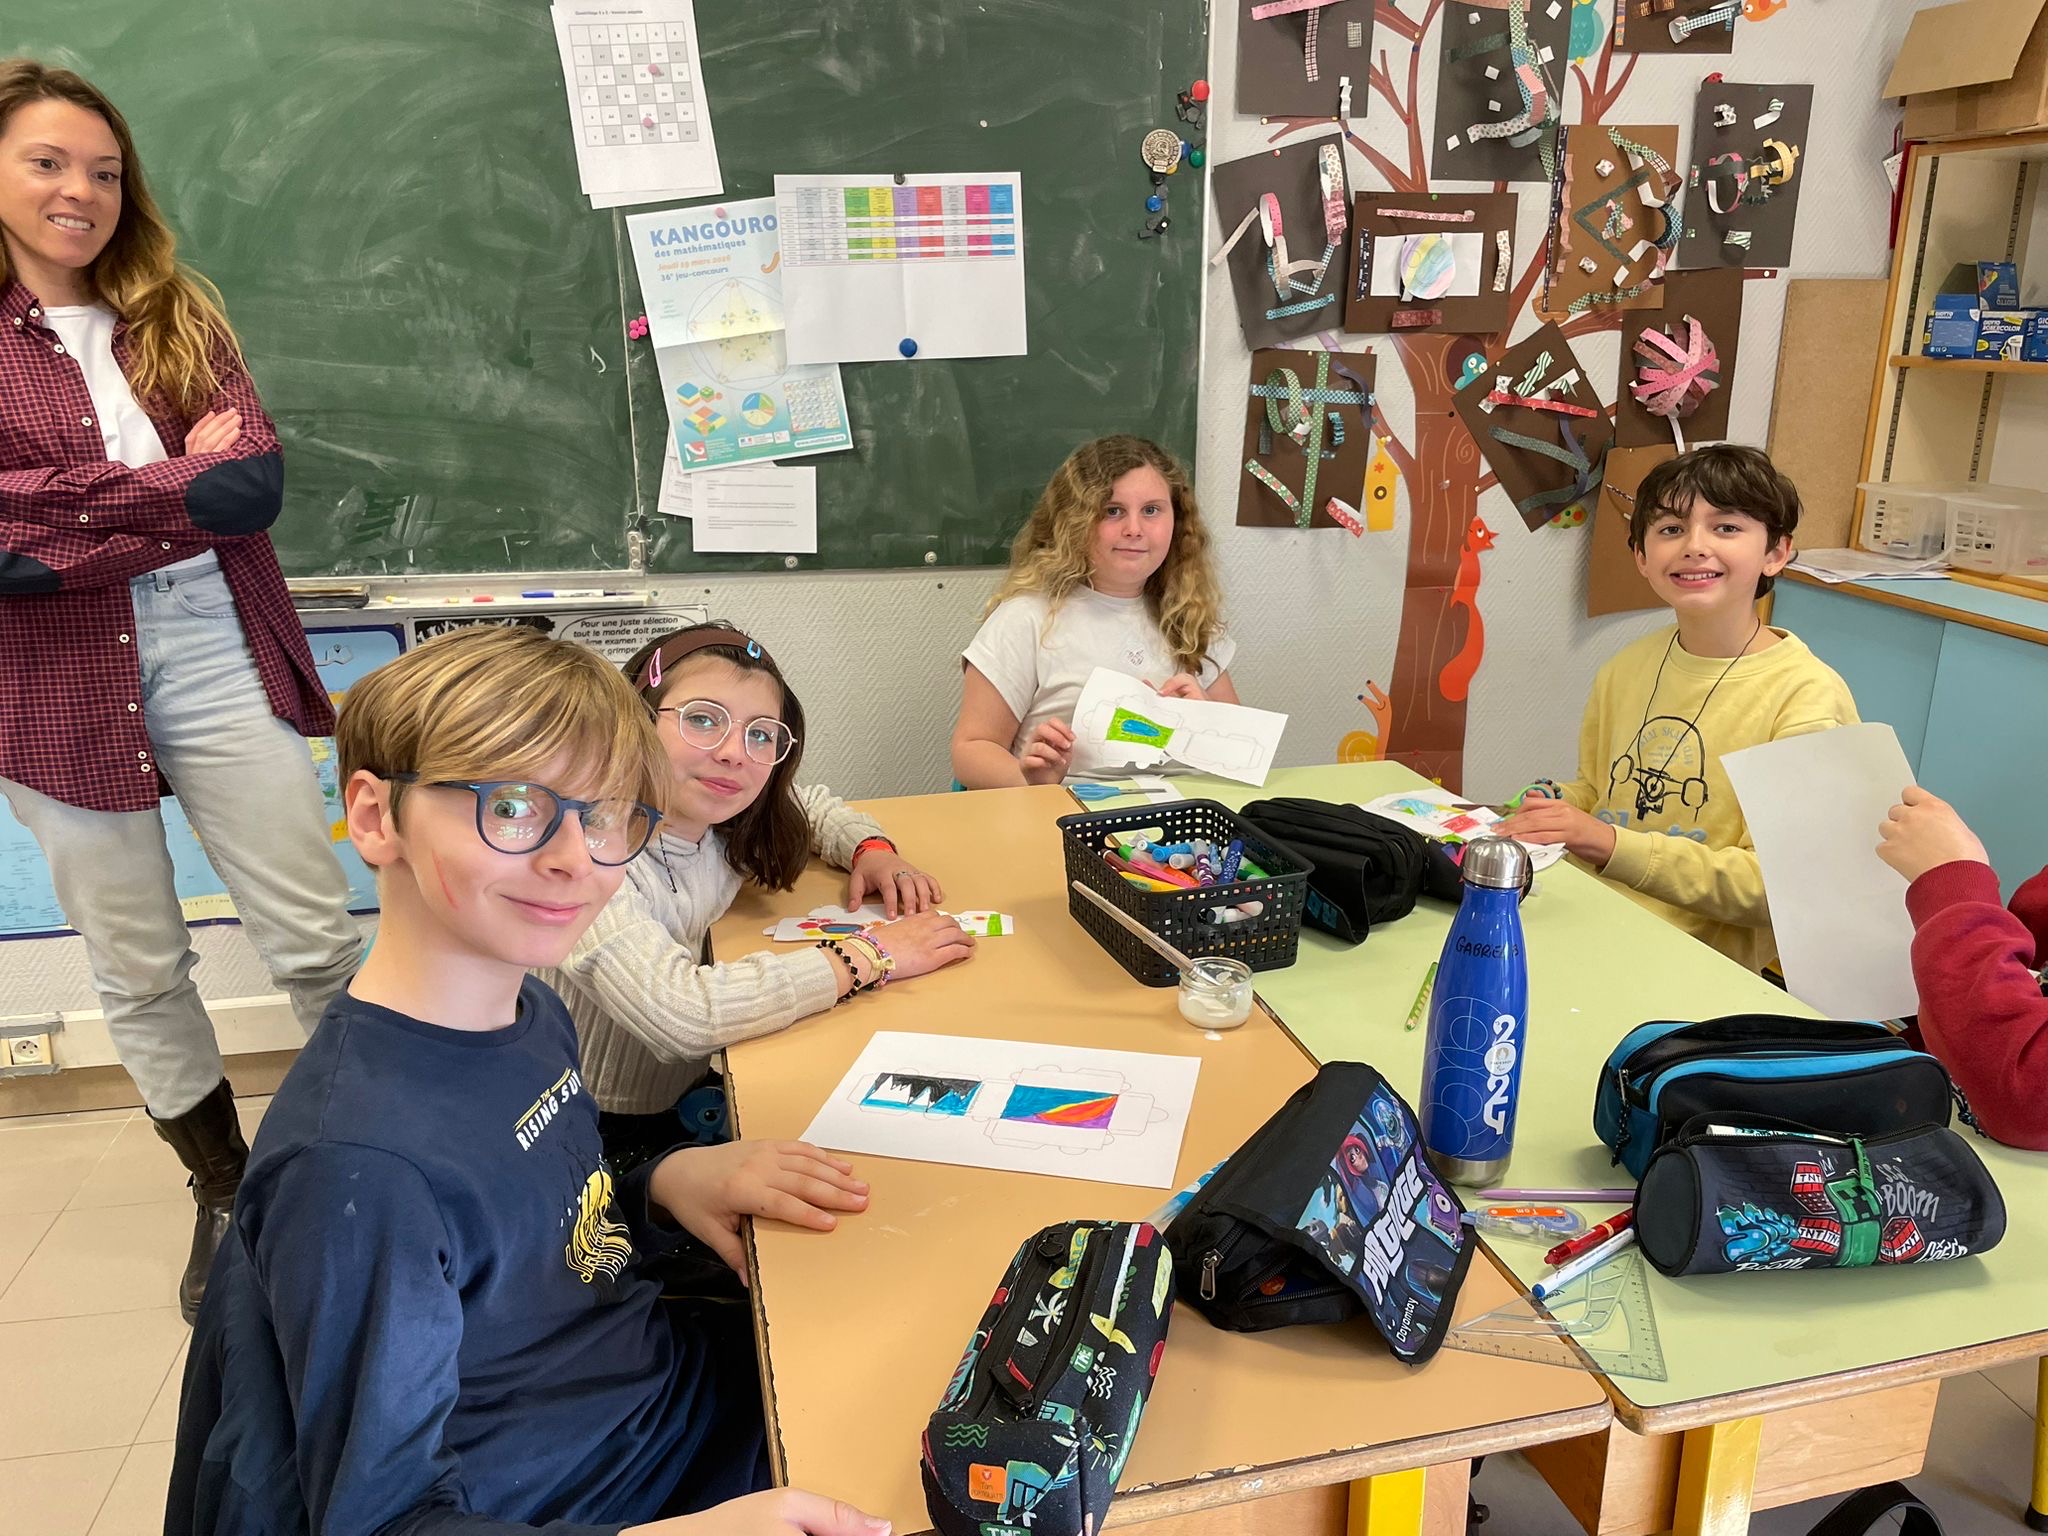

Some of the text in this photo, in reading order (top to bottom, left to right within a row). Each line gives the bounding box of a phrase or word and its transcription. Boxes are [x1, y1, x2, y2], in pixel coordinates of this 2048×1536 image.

[650, 215, 778, 247] KANGOURO
[654, 240, 747, 258] des mathématiques
[581, 619, 600, 628] Pour
[643, 616, 679, 626] sélection
[573, 629, 591, 637] tout
[593, 629, 600, 637] le
[602, 628, 631, 636] monde
[633, 626, 649, 635] doit
[605, 637, 637, 645] examen
[1484, 1014, 1517, 1136] 2024
[540, 1088, 551, 1102] THE
[516, 1095, 559, 1152] RISING
[1800, 1174, 1822, 1183] TNT
[1800, 1228, 1825, 1240] TNT
